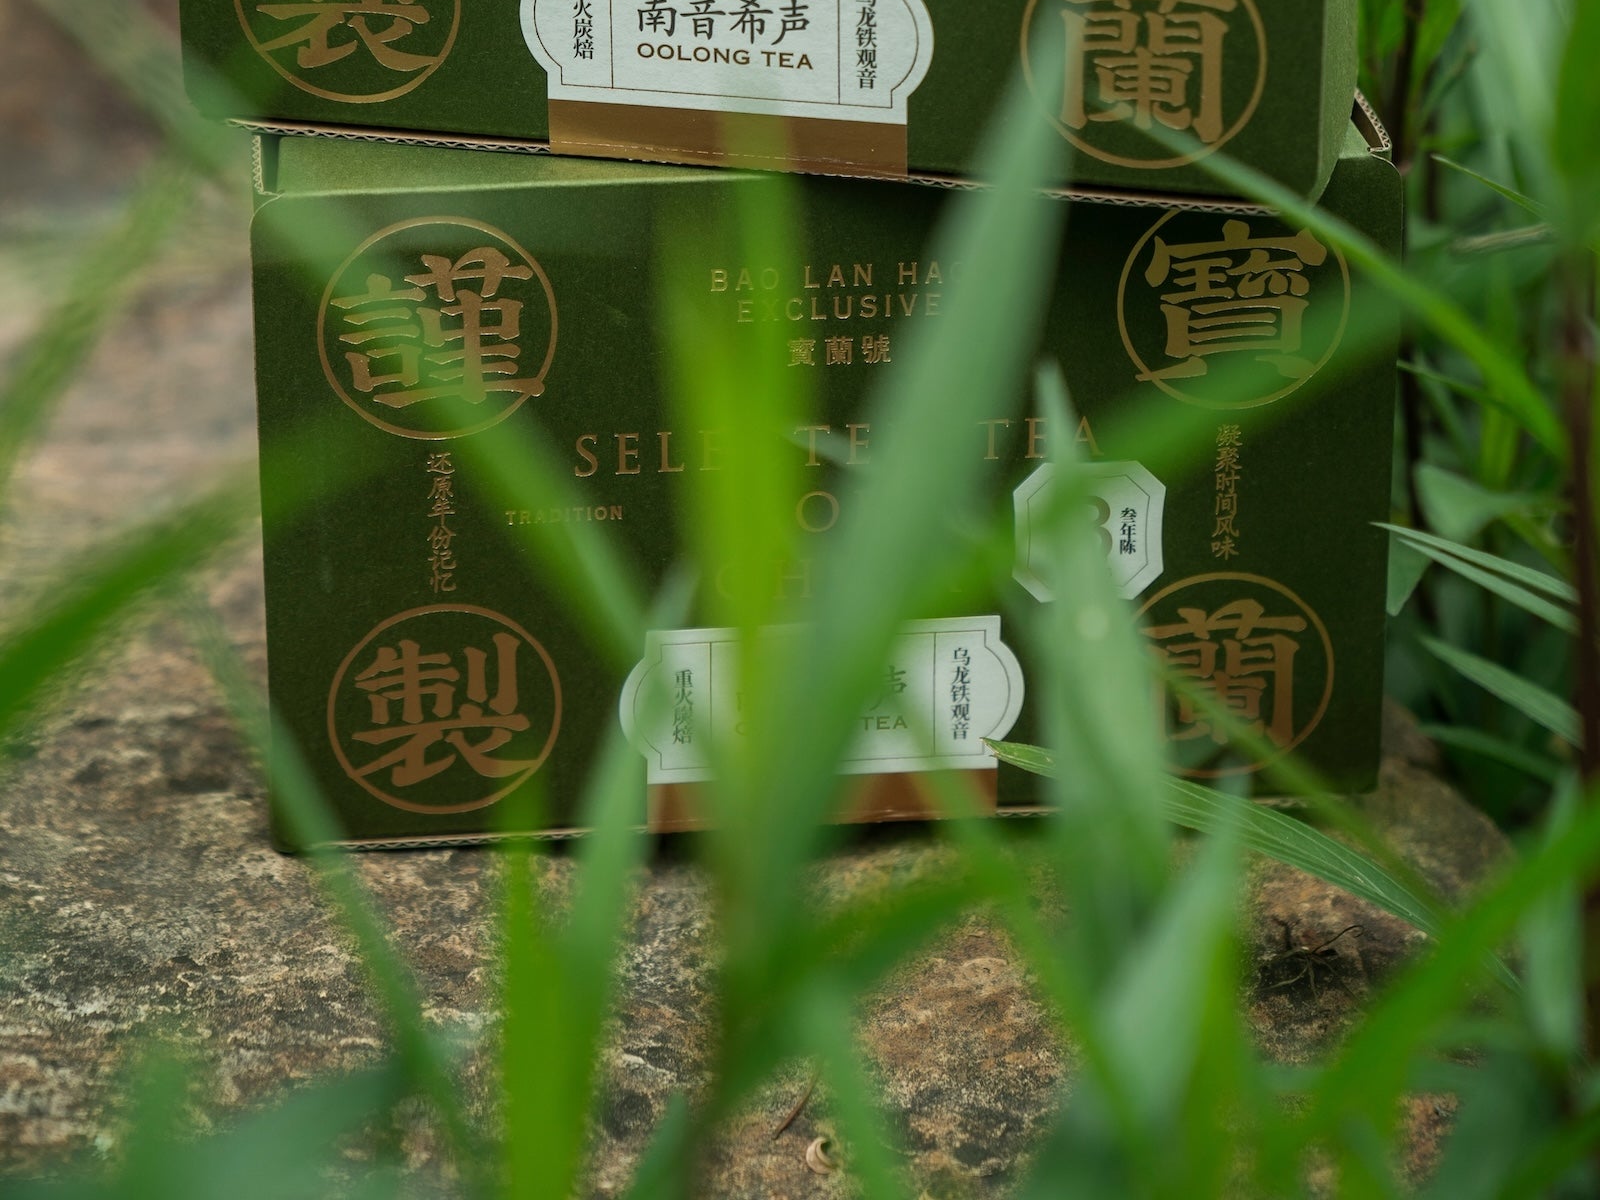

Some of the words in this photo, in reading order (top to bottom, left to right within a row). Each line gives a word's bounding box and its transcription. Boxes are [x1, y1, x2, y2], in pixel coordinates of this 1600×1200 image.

[636, 42, 750, 66] OOLONG
[760, 50, 814, 70] TEA
[710, 267, 780, 293] BAO
[803, 263, 873, 289] LAN
[330, 246, 546, 409] 謹
[573, 422, 895, 478] SELETE
[976, 415, 1105, 460] TEA
[426, 452, 457, 594] 还原年份记忆
[504, 505, 624, 526] TRADITION
[1119, 507, 1138, 555] 叁年陈
[1210, 423, 1243, 561] 凝聚时间风味
[351, 632, 541, 788] 製
[950, 647, 971, 740] 乌龙铁观音
[1138, 598, 1308, 748] 蘭
[861, 715, 908, 731] TEA
